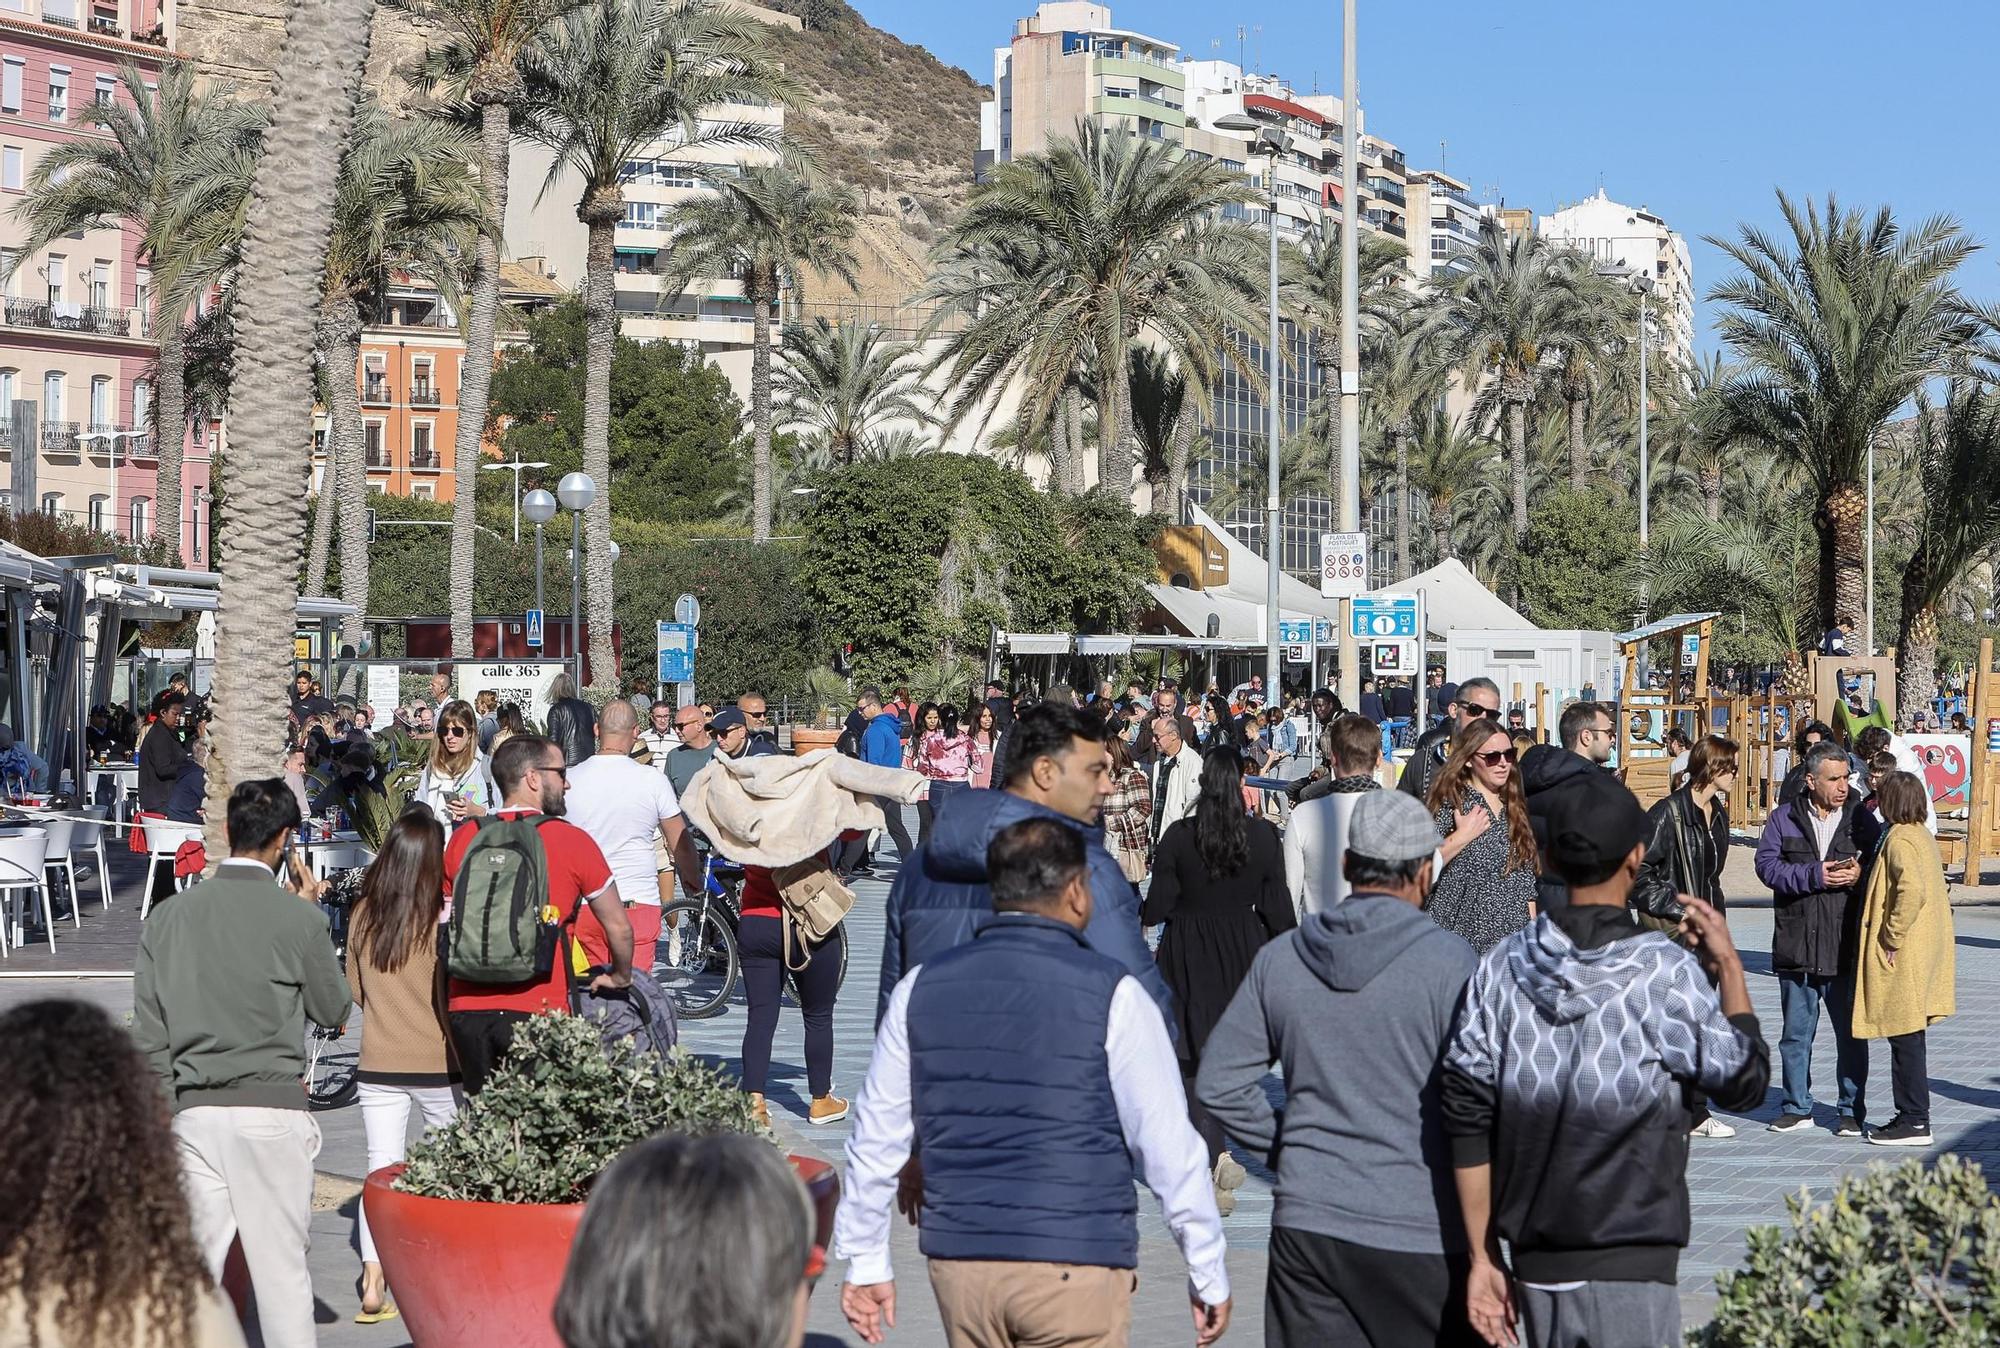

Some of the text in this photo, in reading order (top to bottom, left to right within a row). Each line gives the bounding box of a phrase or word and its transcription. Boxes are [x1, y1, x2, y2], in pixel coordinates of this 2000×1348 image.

[1381, 618, 1387, 633] 1
[1291, 632, 1296, 640] 2
[482, 665, 540, 677] calle 365
